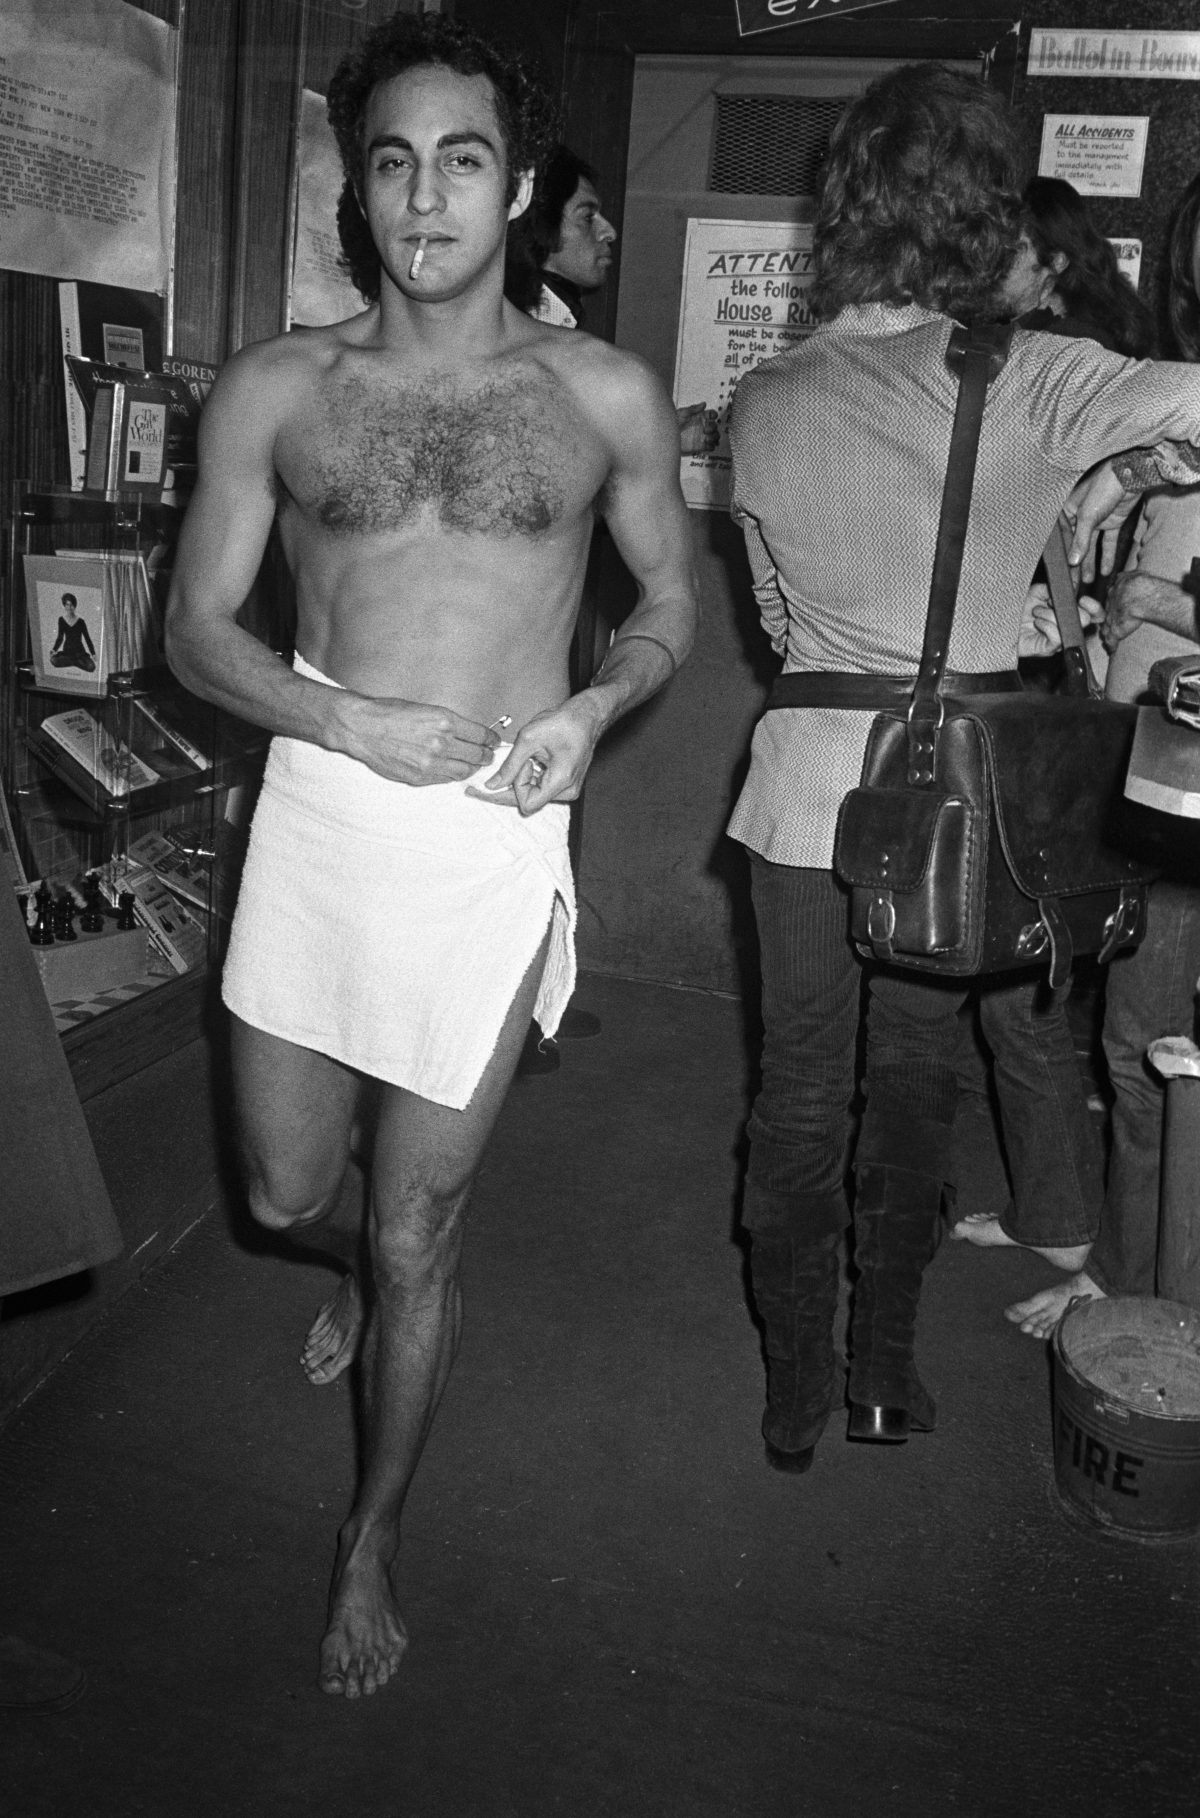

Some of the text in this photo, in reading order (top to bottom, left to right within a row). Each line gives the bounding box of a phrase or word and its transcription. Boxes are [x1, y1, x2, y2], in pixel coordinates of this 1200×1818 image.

[1039, 36, 1131, 70] Bulletin
[1055, 124, 1135, 139] ALL ACCIDENTS
[1060, 140, 1125, 151] Must be reported
[1057, 150, 1066, 159] to
[1068, 151, 1081, 159] the
[731, 279, 758, 297] the
[717, 296, 773, 322] House
[728, 328, 757, 339] must
[761, 328, 774, 340] be
[727, 339, 746, 351] for
[749, 341, 767, 353] the
[724, 352, 739, 364] all
[742, 352, 755, 365] of
[1059, 1411, 1144, 1499] FIRE
